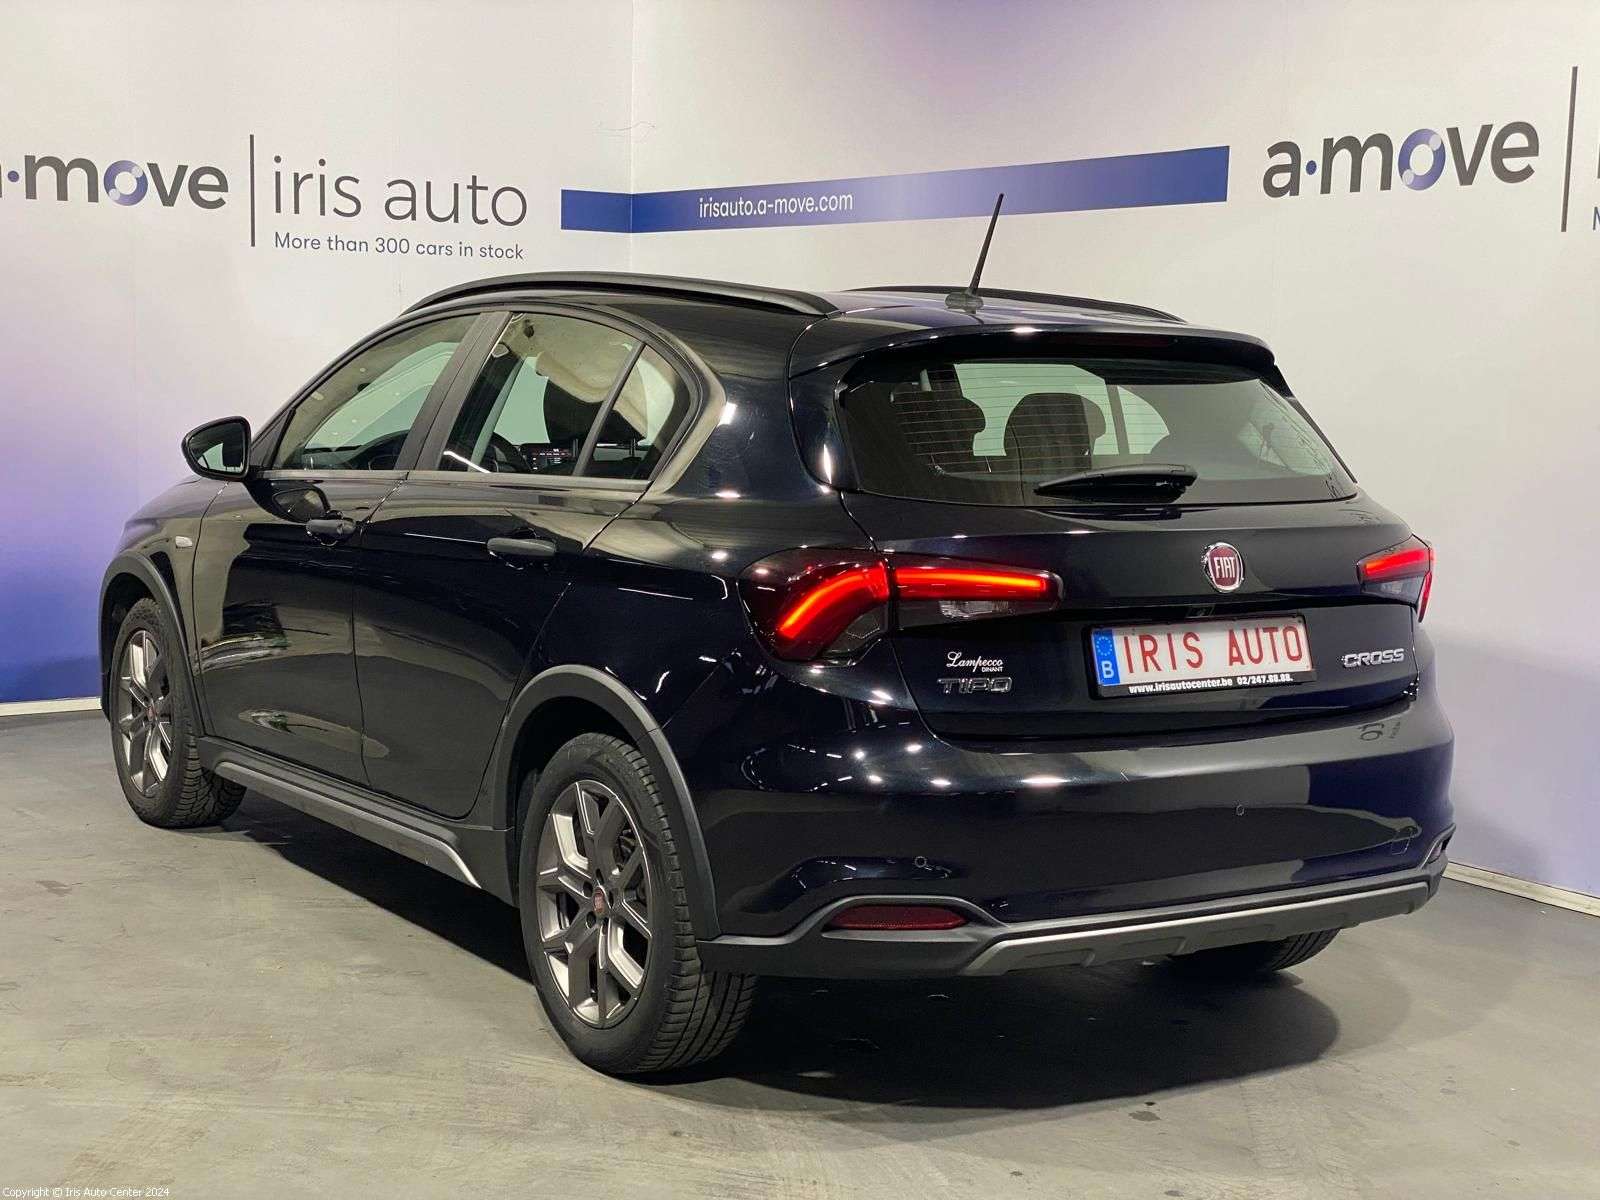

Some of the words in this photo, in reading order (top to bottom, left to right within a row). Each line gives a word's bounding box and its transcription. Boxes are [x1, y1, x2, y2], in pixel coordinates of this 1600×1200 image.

[273, 155, 362, 218] iris
[384, 175, 528, 226] auto
[699, 193, 854, 218] irisauto.a-move.com
[274, 231, 321, 250] More
[326, 235, 369, 253] than
[375, 236, 411, 254] 300
[415, 241, 454, 257] cars
[458, 241, 474, 257] in
[479, 244, 524, 260] stock
[1213, 556, 1236, 579] FIAT
[1123, 630, 1204, 674] IRIS
[1228, 624, 1304, 667] AUTO
[1342, 647, 1405, 668] CROSS
[945, 650, 1004, 673] Lampecco
[1102, 660, 1115, 679] B
[937, 677, 1013, 694] TIPO
[1128, 676, 1234, 694] www.irisautocenter.be
